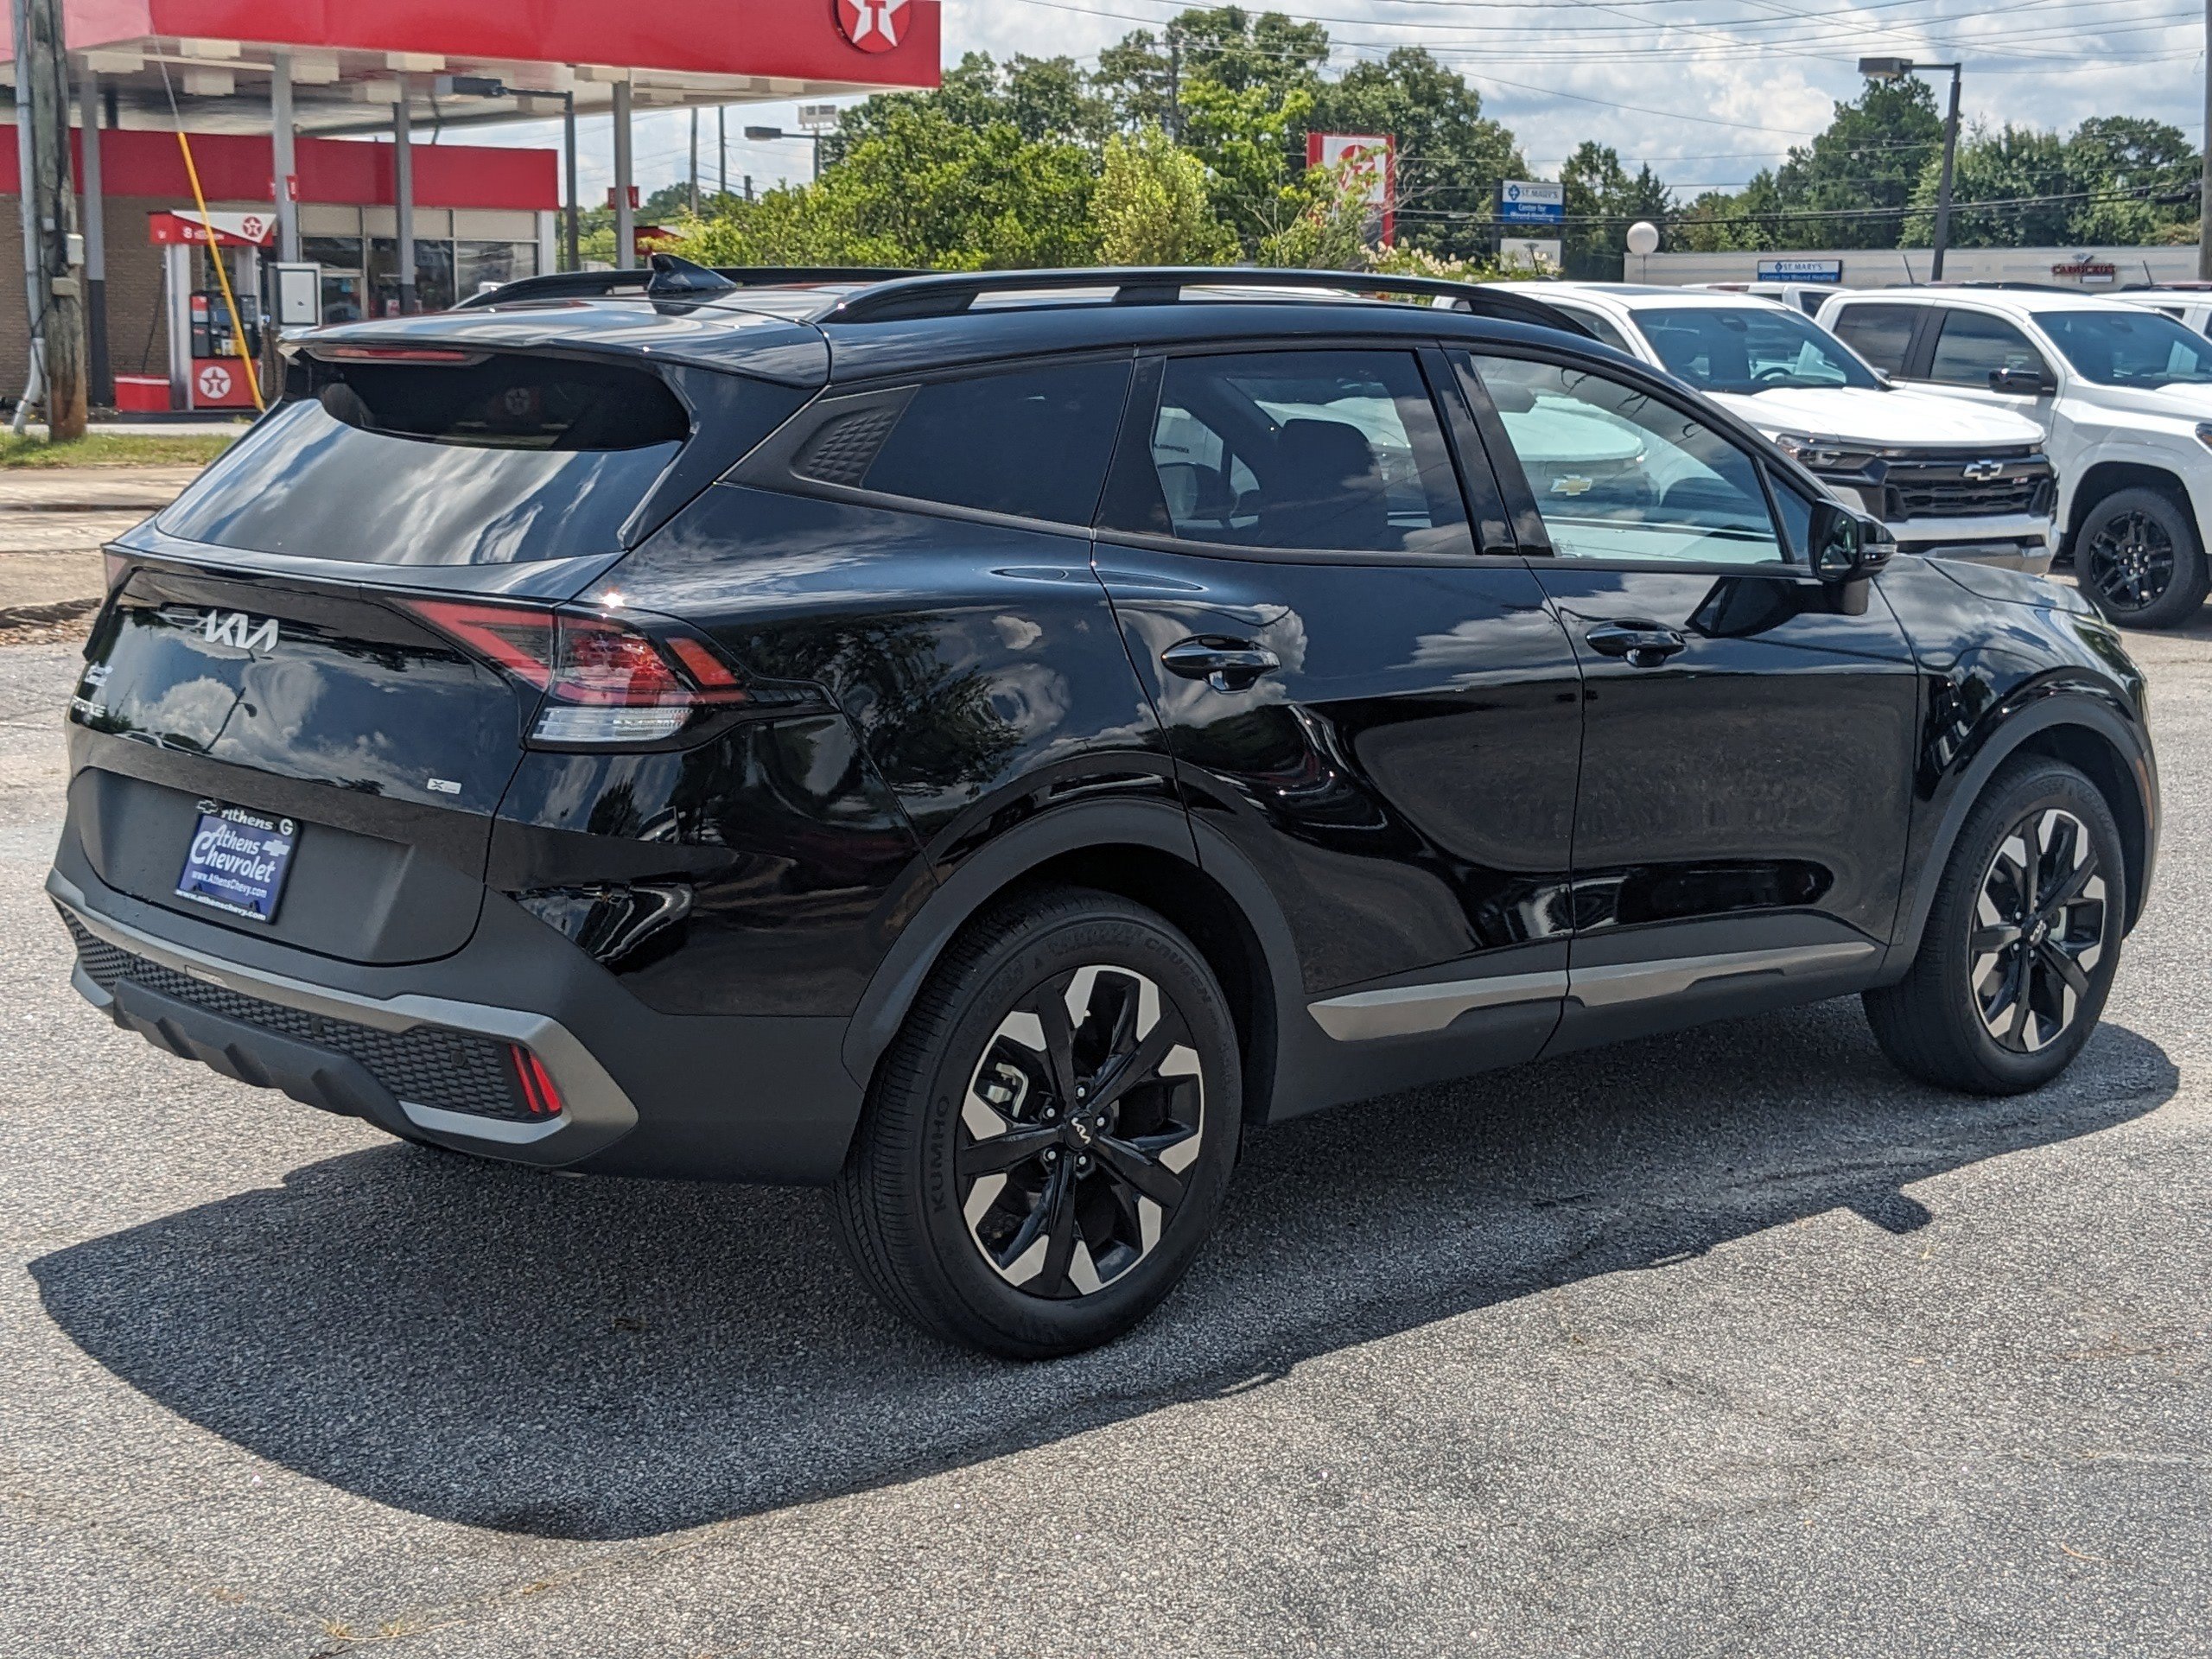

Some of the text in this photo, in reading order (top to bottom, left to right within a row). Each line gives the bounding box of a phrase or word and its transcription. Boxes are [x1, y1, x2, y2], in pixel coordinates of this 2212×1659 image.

[205, 608, 279, 653] KIA
[190, 830, 276, 883] Chevrolet
[211, 823, 260, 855] Athens
[192, 870, 268, 898] www.AthensChevy.com
[174, 888, 266, 921] www.athenschevy.com
[930, 1096, 950, 1215] KUMHO
